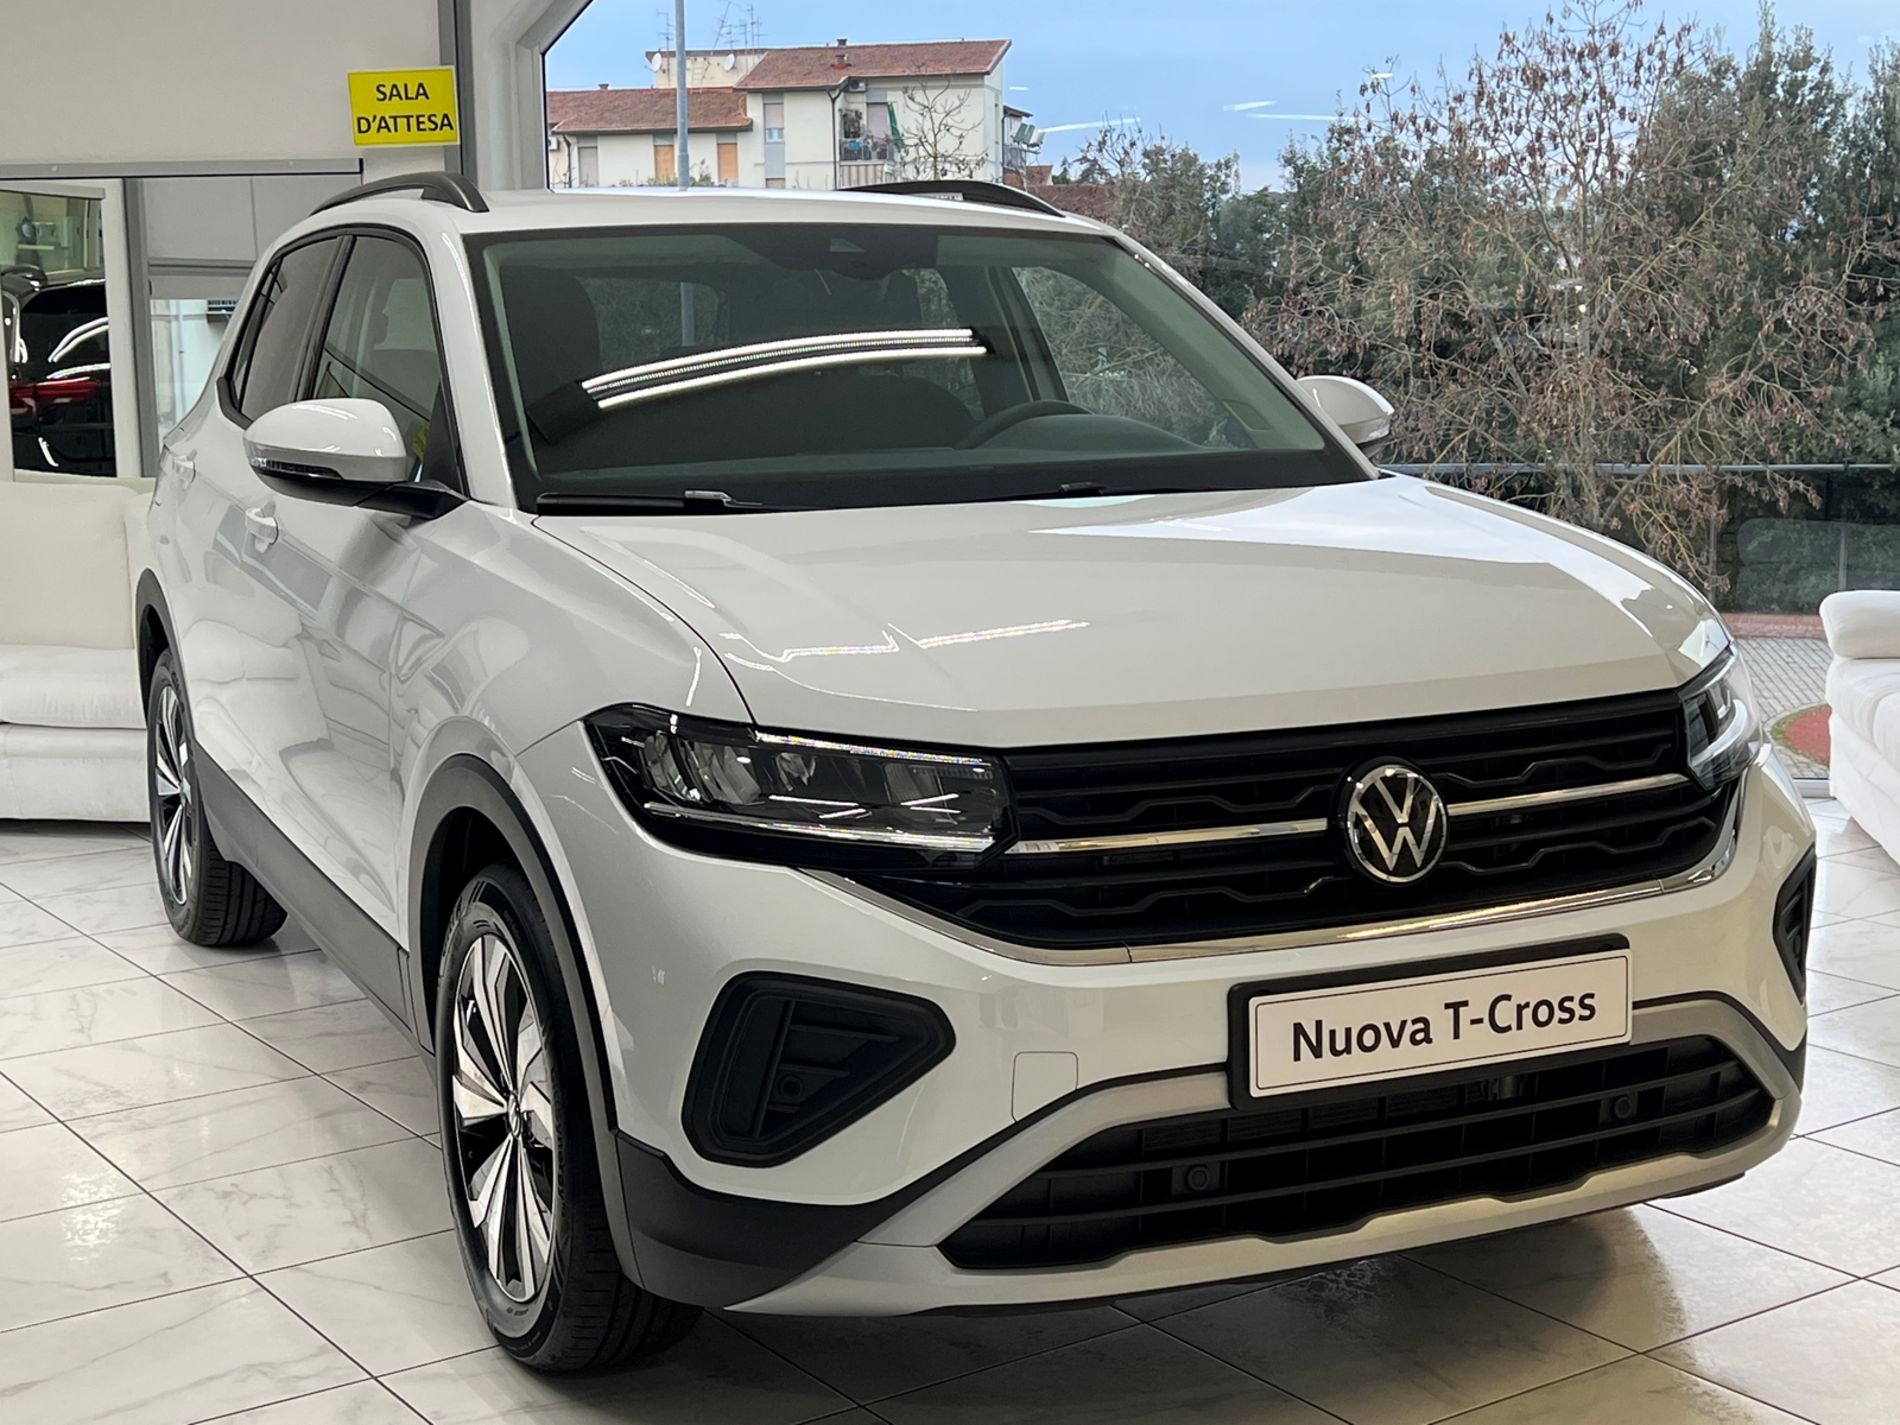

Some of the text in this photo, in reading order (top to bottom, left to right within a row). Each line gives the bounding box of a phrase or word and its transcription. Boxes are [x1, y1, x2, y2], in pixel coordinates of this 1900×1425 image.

[376, 82, 430, 102] SALA
[356, 113, 454, 134] D'ATTESA
[1349, 768, 1443, 875] VW
[1292, 992, 1596, 1062] Nuova T-Cross
